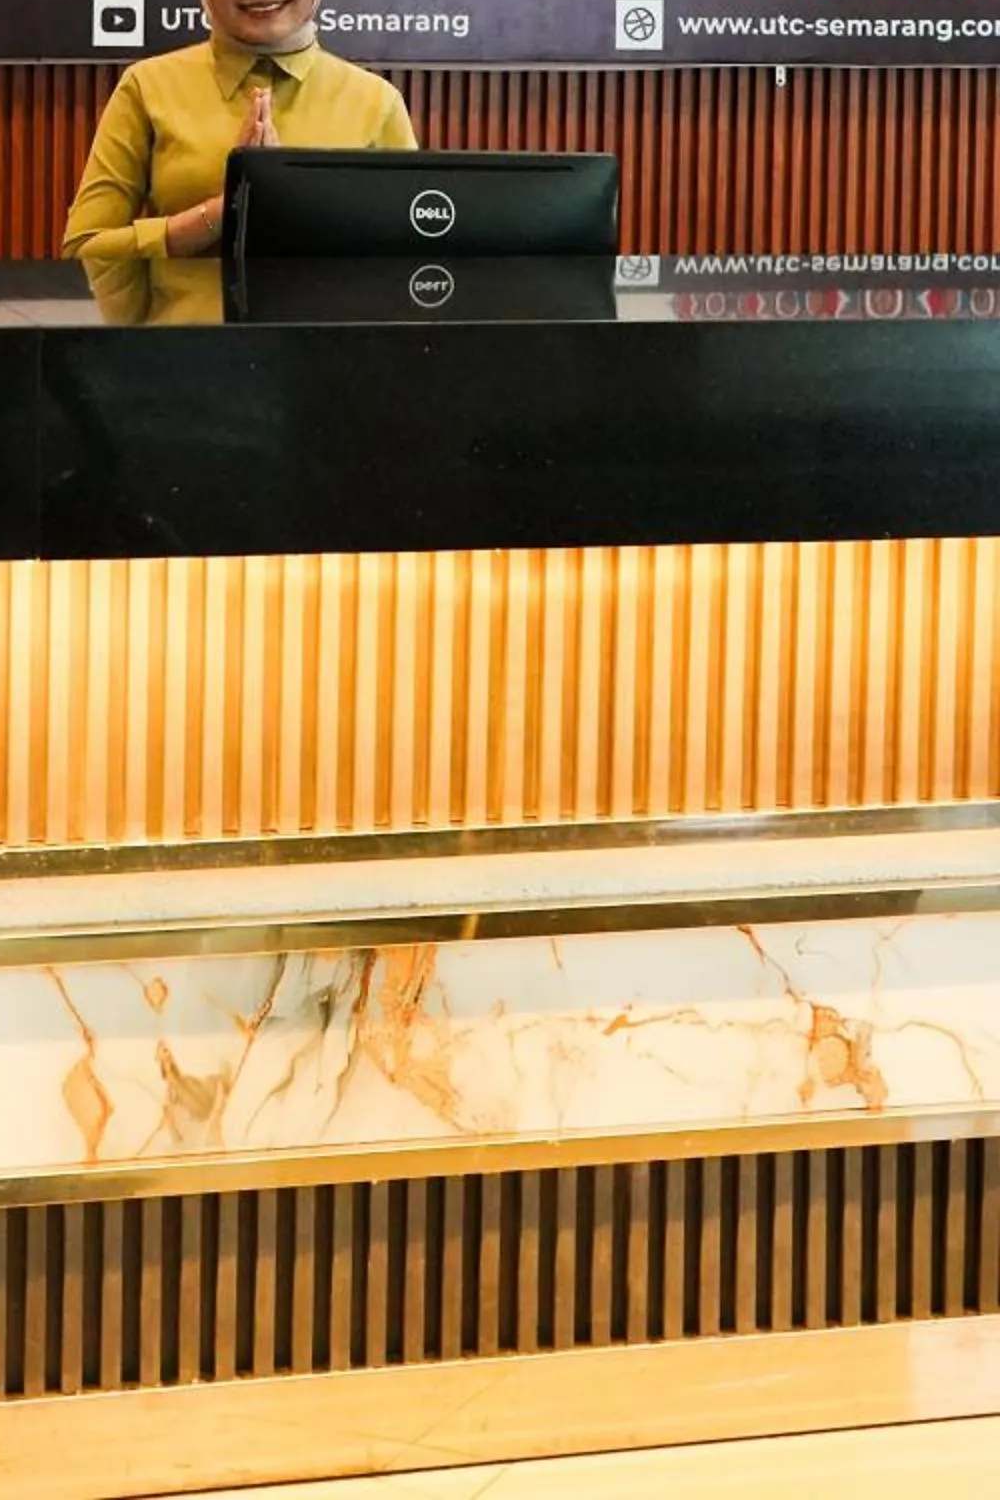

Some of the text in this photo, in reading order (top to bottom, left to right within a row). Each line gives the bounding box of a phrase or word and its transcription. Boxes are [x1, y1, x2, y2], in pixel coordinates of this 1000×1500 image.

[319, 8, 470, 37] Semarang
[677, 14, 1000, 42] www.utc-semarang.co
[415, 207, 451, 220] DELL
